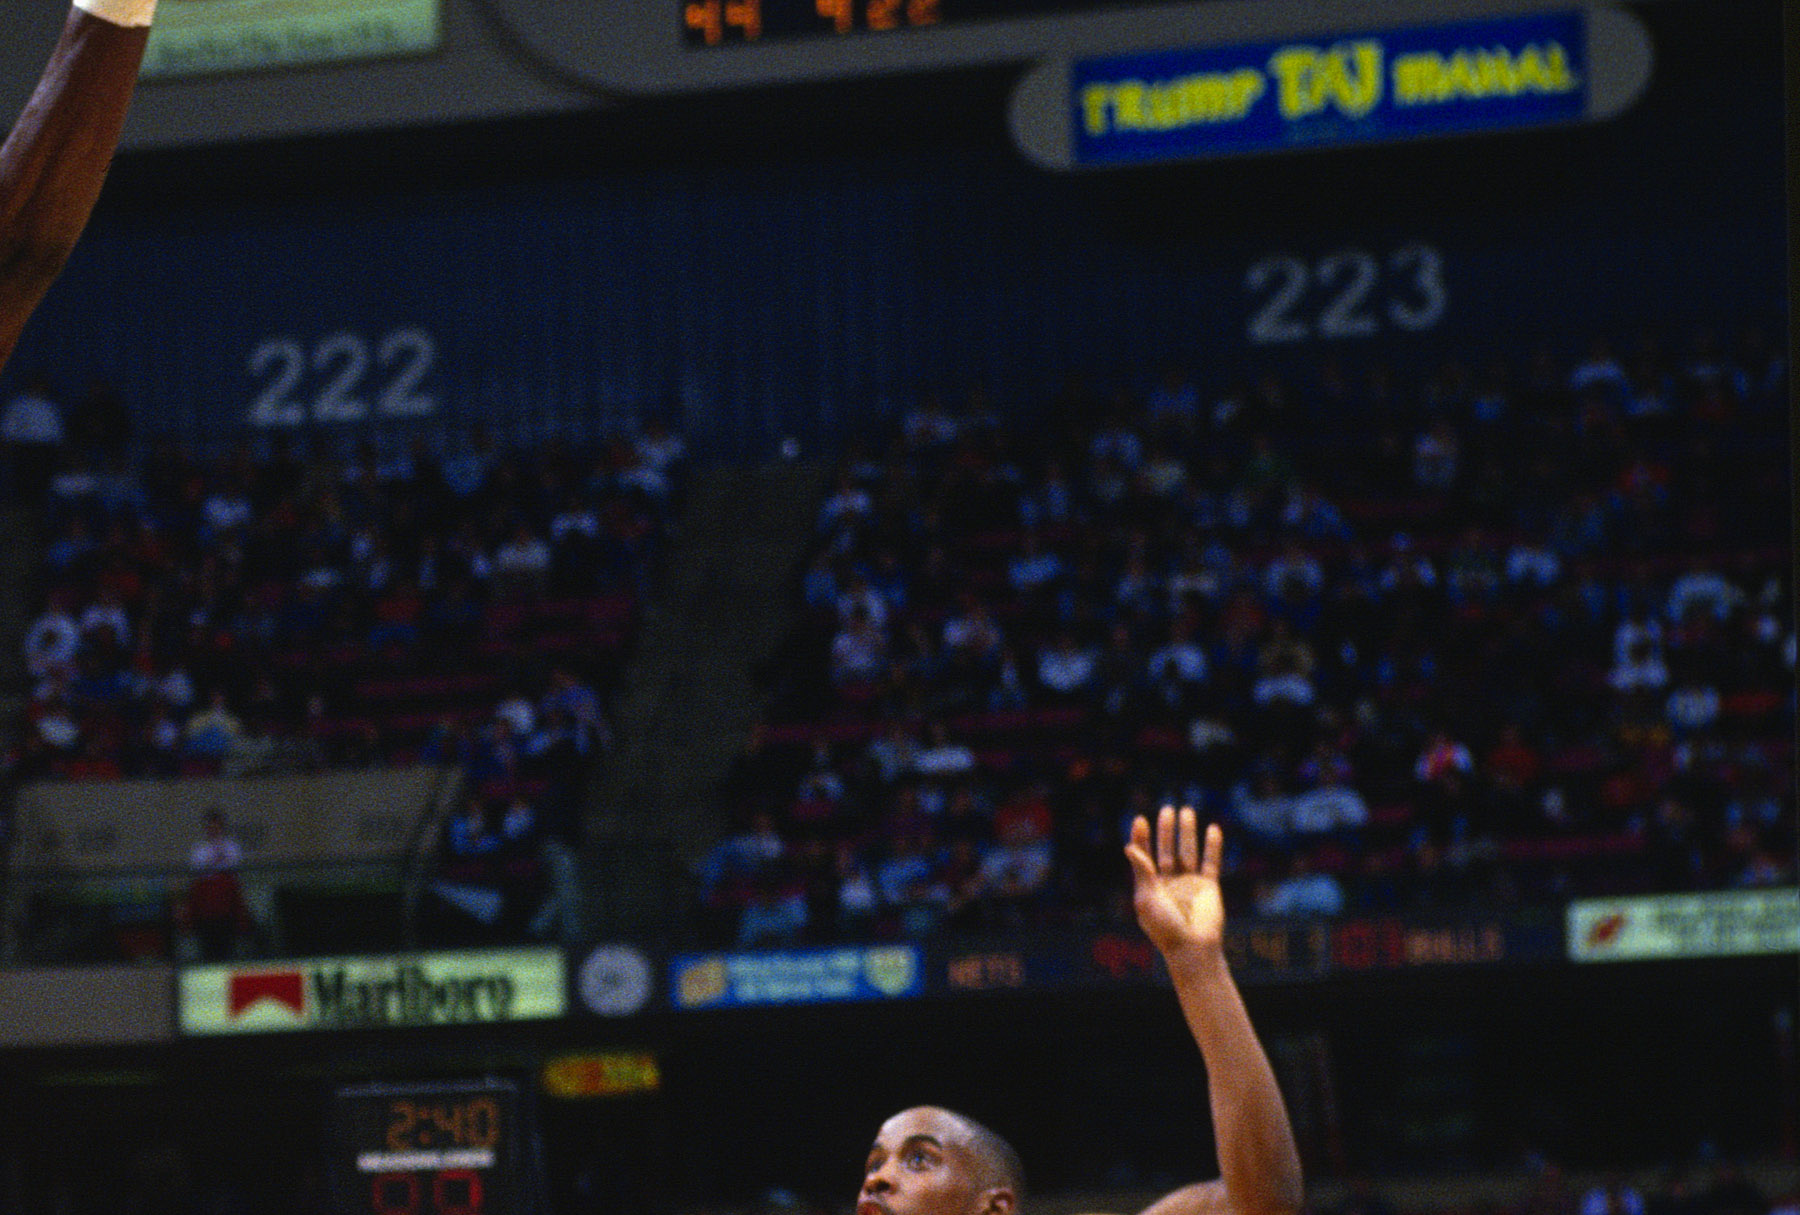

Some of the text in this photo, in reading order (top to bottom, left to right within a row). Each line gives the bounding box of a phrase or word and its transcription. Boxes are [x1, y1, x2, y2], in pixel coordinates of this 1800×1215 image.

[1244, 244, 1449, 342] 223
[246, 326, 440, 428] 222
[314, 961, 513, 1028] Marlboro
[385, 1097, 499, 1150] 2:40
